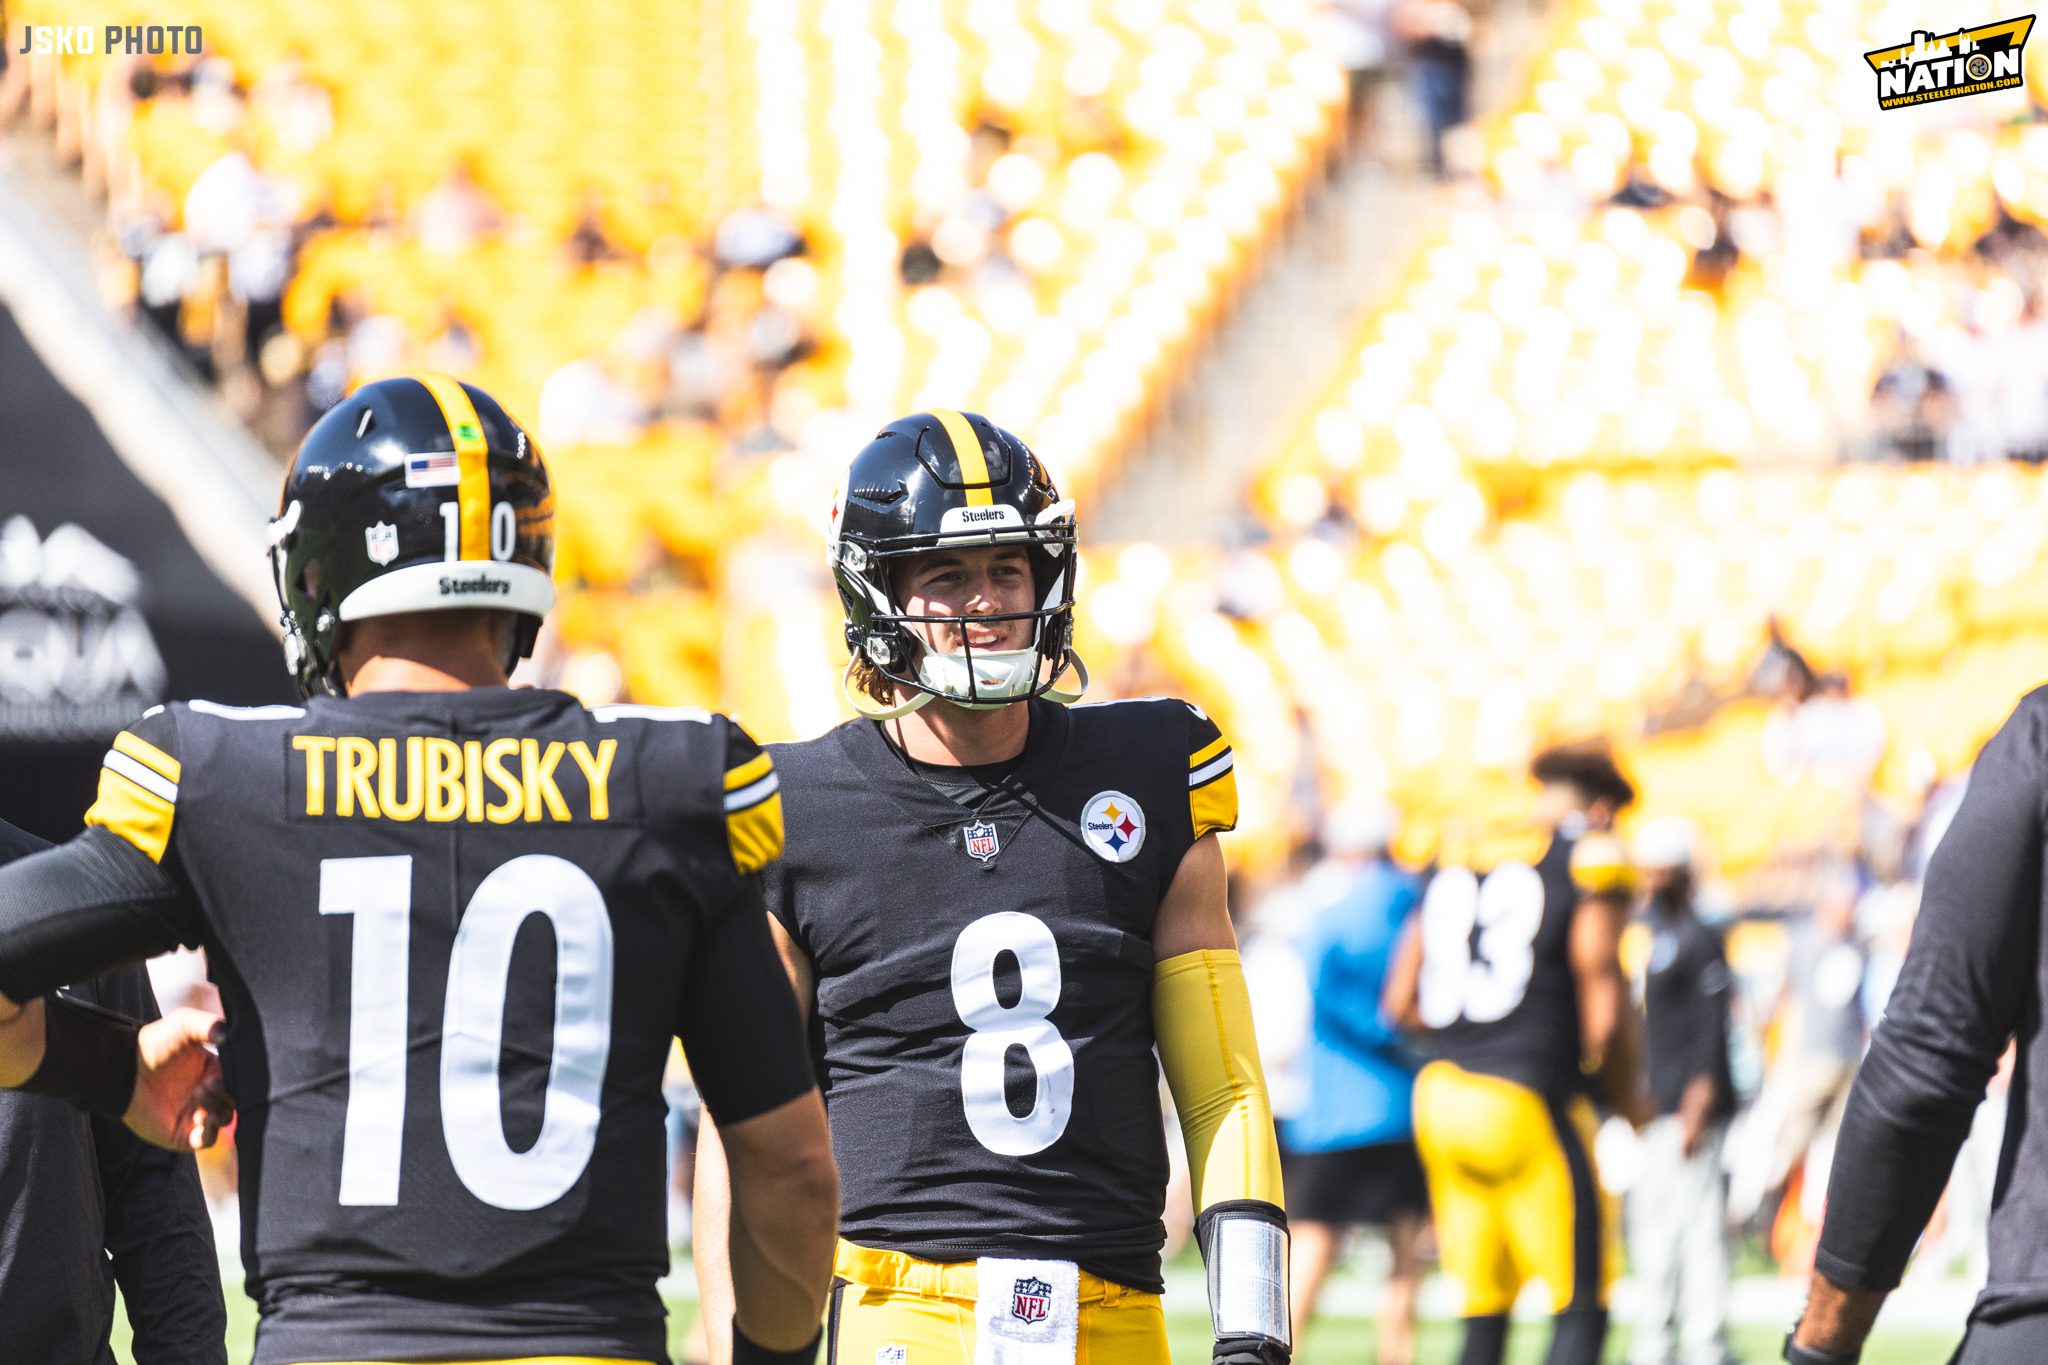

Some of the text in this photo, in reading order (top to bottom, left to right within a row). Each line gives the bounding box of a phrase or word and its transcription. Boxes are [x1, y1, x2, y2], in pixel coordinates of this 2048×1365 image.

[962, 508, 1005, 523] Steelers
[439, 501, 516, 562] 10
[439, 573, 511, 595] Steelers
[291, 735, 618, 823] TRUBISKY
[1087, 821, 1114, 831] Steelers
[971, 838, 996, 854] NFL
[319, 854, 614, 1211] 10
[951, 911, 1075, 1157] 8
[1014, 1294, 1047, 1320] NFL
